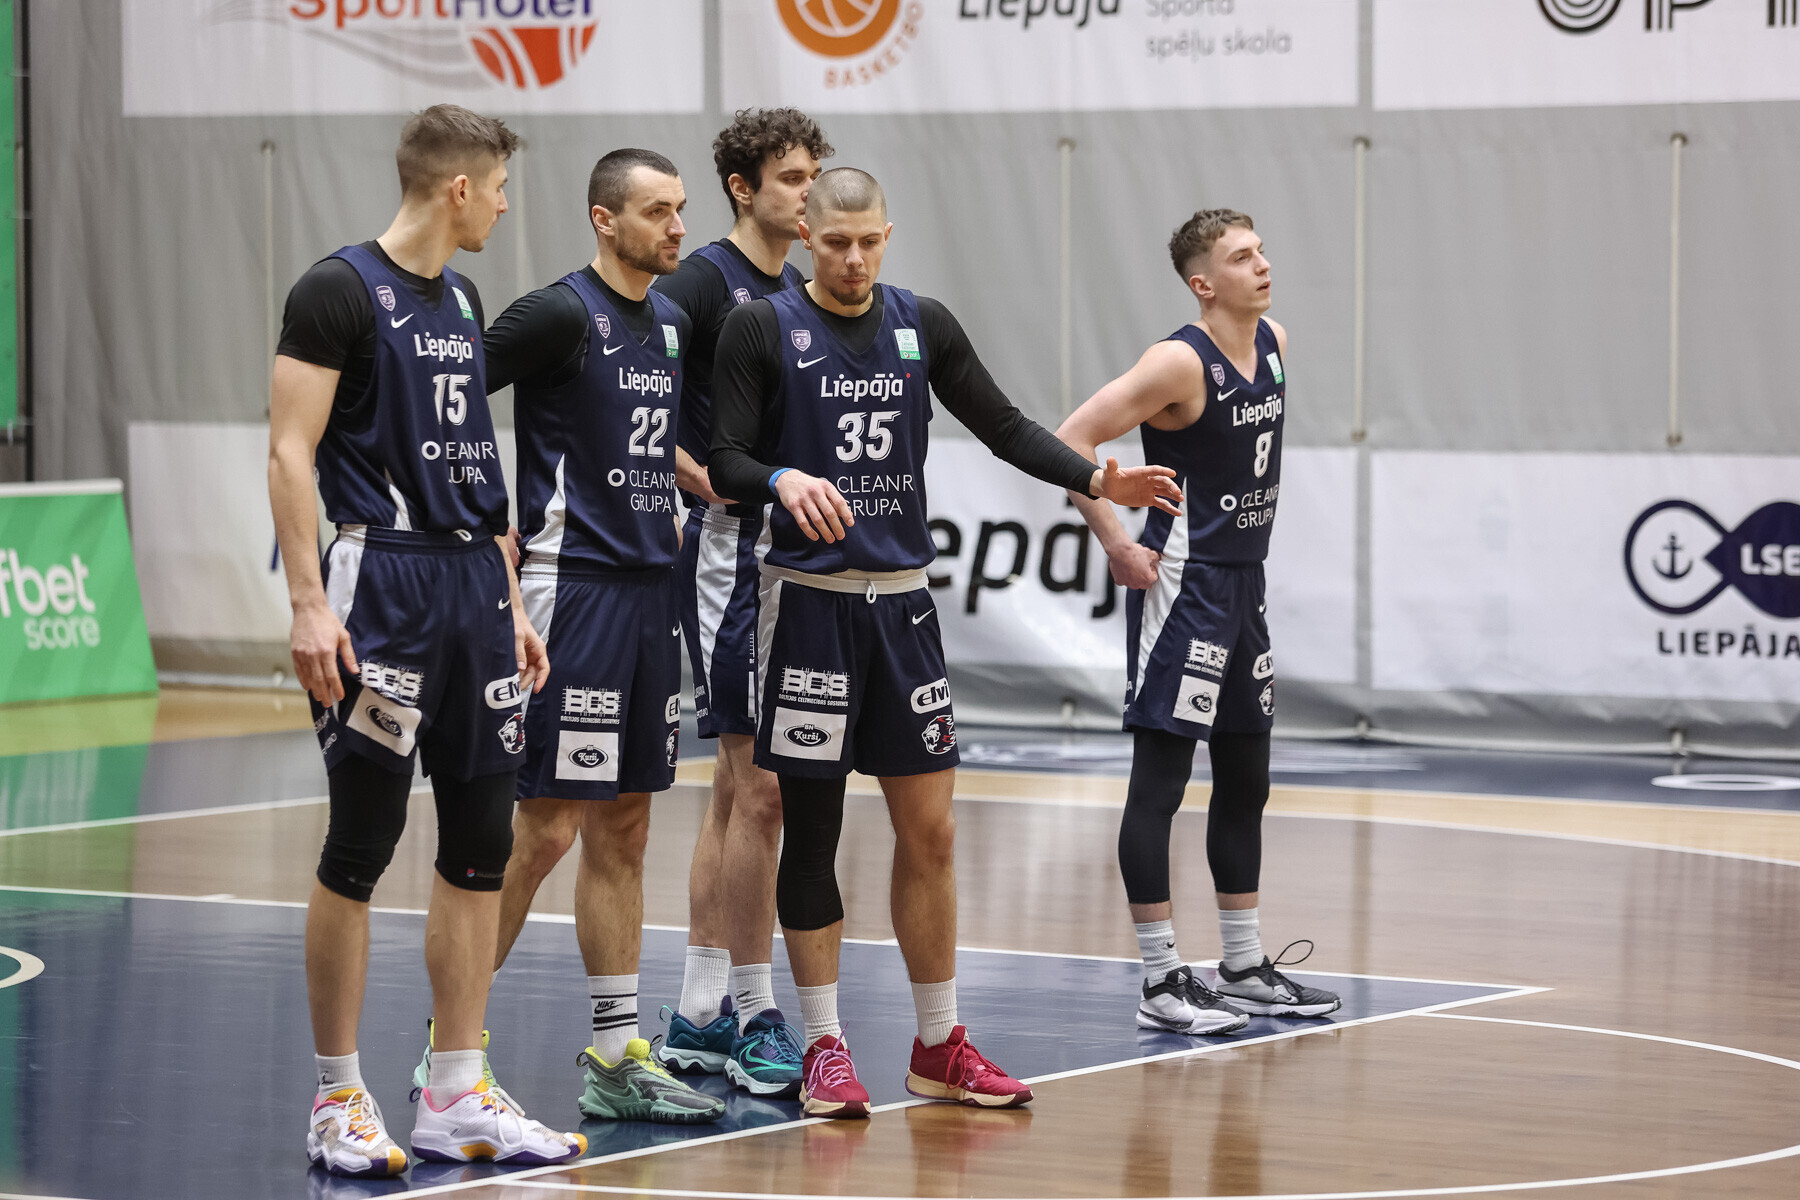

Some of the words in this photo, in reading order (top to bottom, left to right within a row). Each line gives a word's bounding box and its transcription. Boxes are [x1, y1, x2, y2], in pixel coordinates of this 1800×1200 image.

[1222, 27, 1292, 55] skola
[414, 332, 473, 363] Liepāja
[619, 366, 672, 398] Liepāja
[821, 373, 903, 402] Liepāja
[432, 373, 472, 425] 15
[1232, 394, 1283, 427] Liepāja
[628, 406, 670, 457] 22
[835, 410, 902, 463] 35
[1254, 430, 1274, 478] 8
[836, 474, 914, 493] CLEANR
[630, 493, 672, 513] GRUPA
[847, 498, 903, 516] RUPA
[24, 616, 100, 650] score
